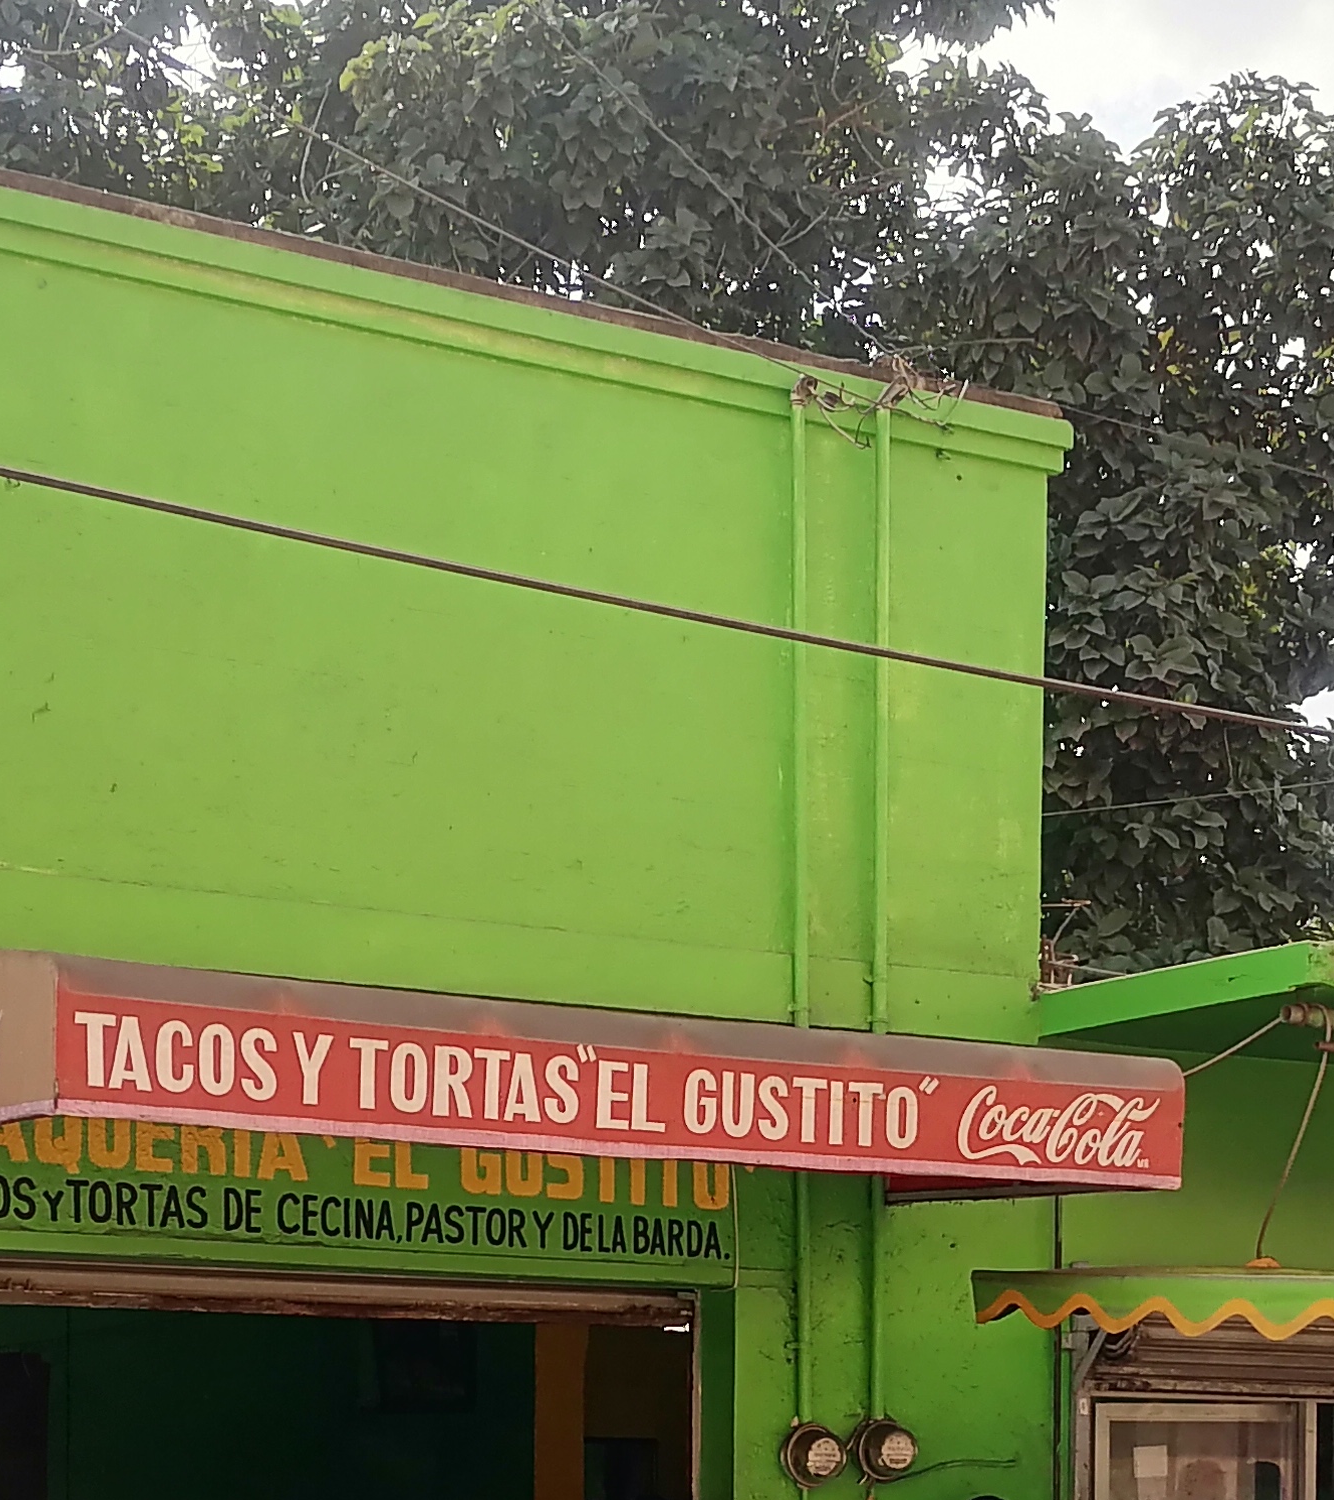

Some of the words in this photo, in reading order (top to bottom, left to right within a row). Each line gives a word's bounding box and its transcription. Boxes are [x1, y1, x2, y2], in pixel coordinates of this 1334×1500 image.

[75, 1011, 277, 1102] TACOS
[293, 1031, 335, 1106] Y
[350, 1038, 578, 1124] TORTAS
[957, 1084, 1160, 1169] Coca-Cola
[66, 1179, 208, 1229] TORTAS
[224, 1187, 262, 1233] DE
[406, 1201, 528, 1248] PASTOR
[532, 1211, 554, 1249] Y
[563, 1212, 592, 1252] DE
[598, 1215, 627, 1254] LA
